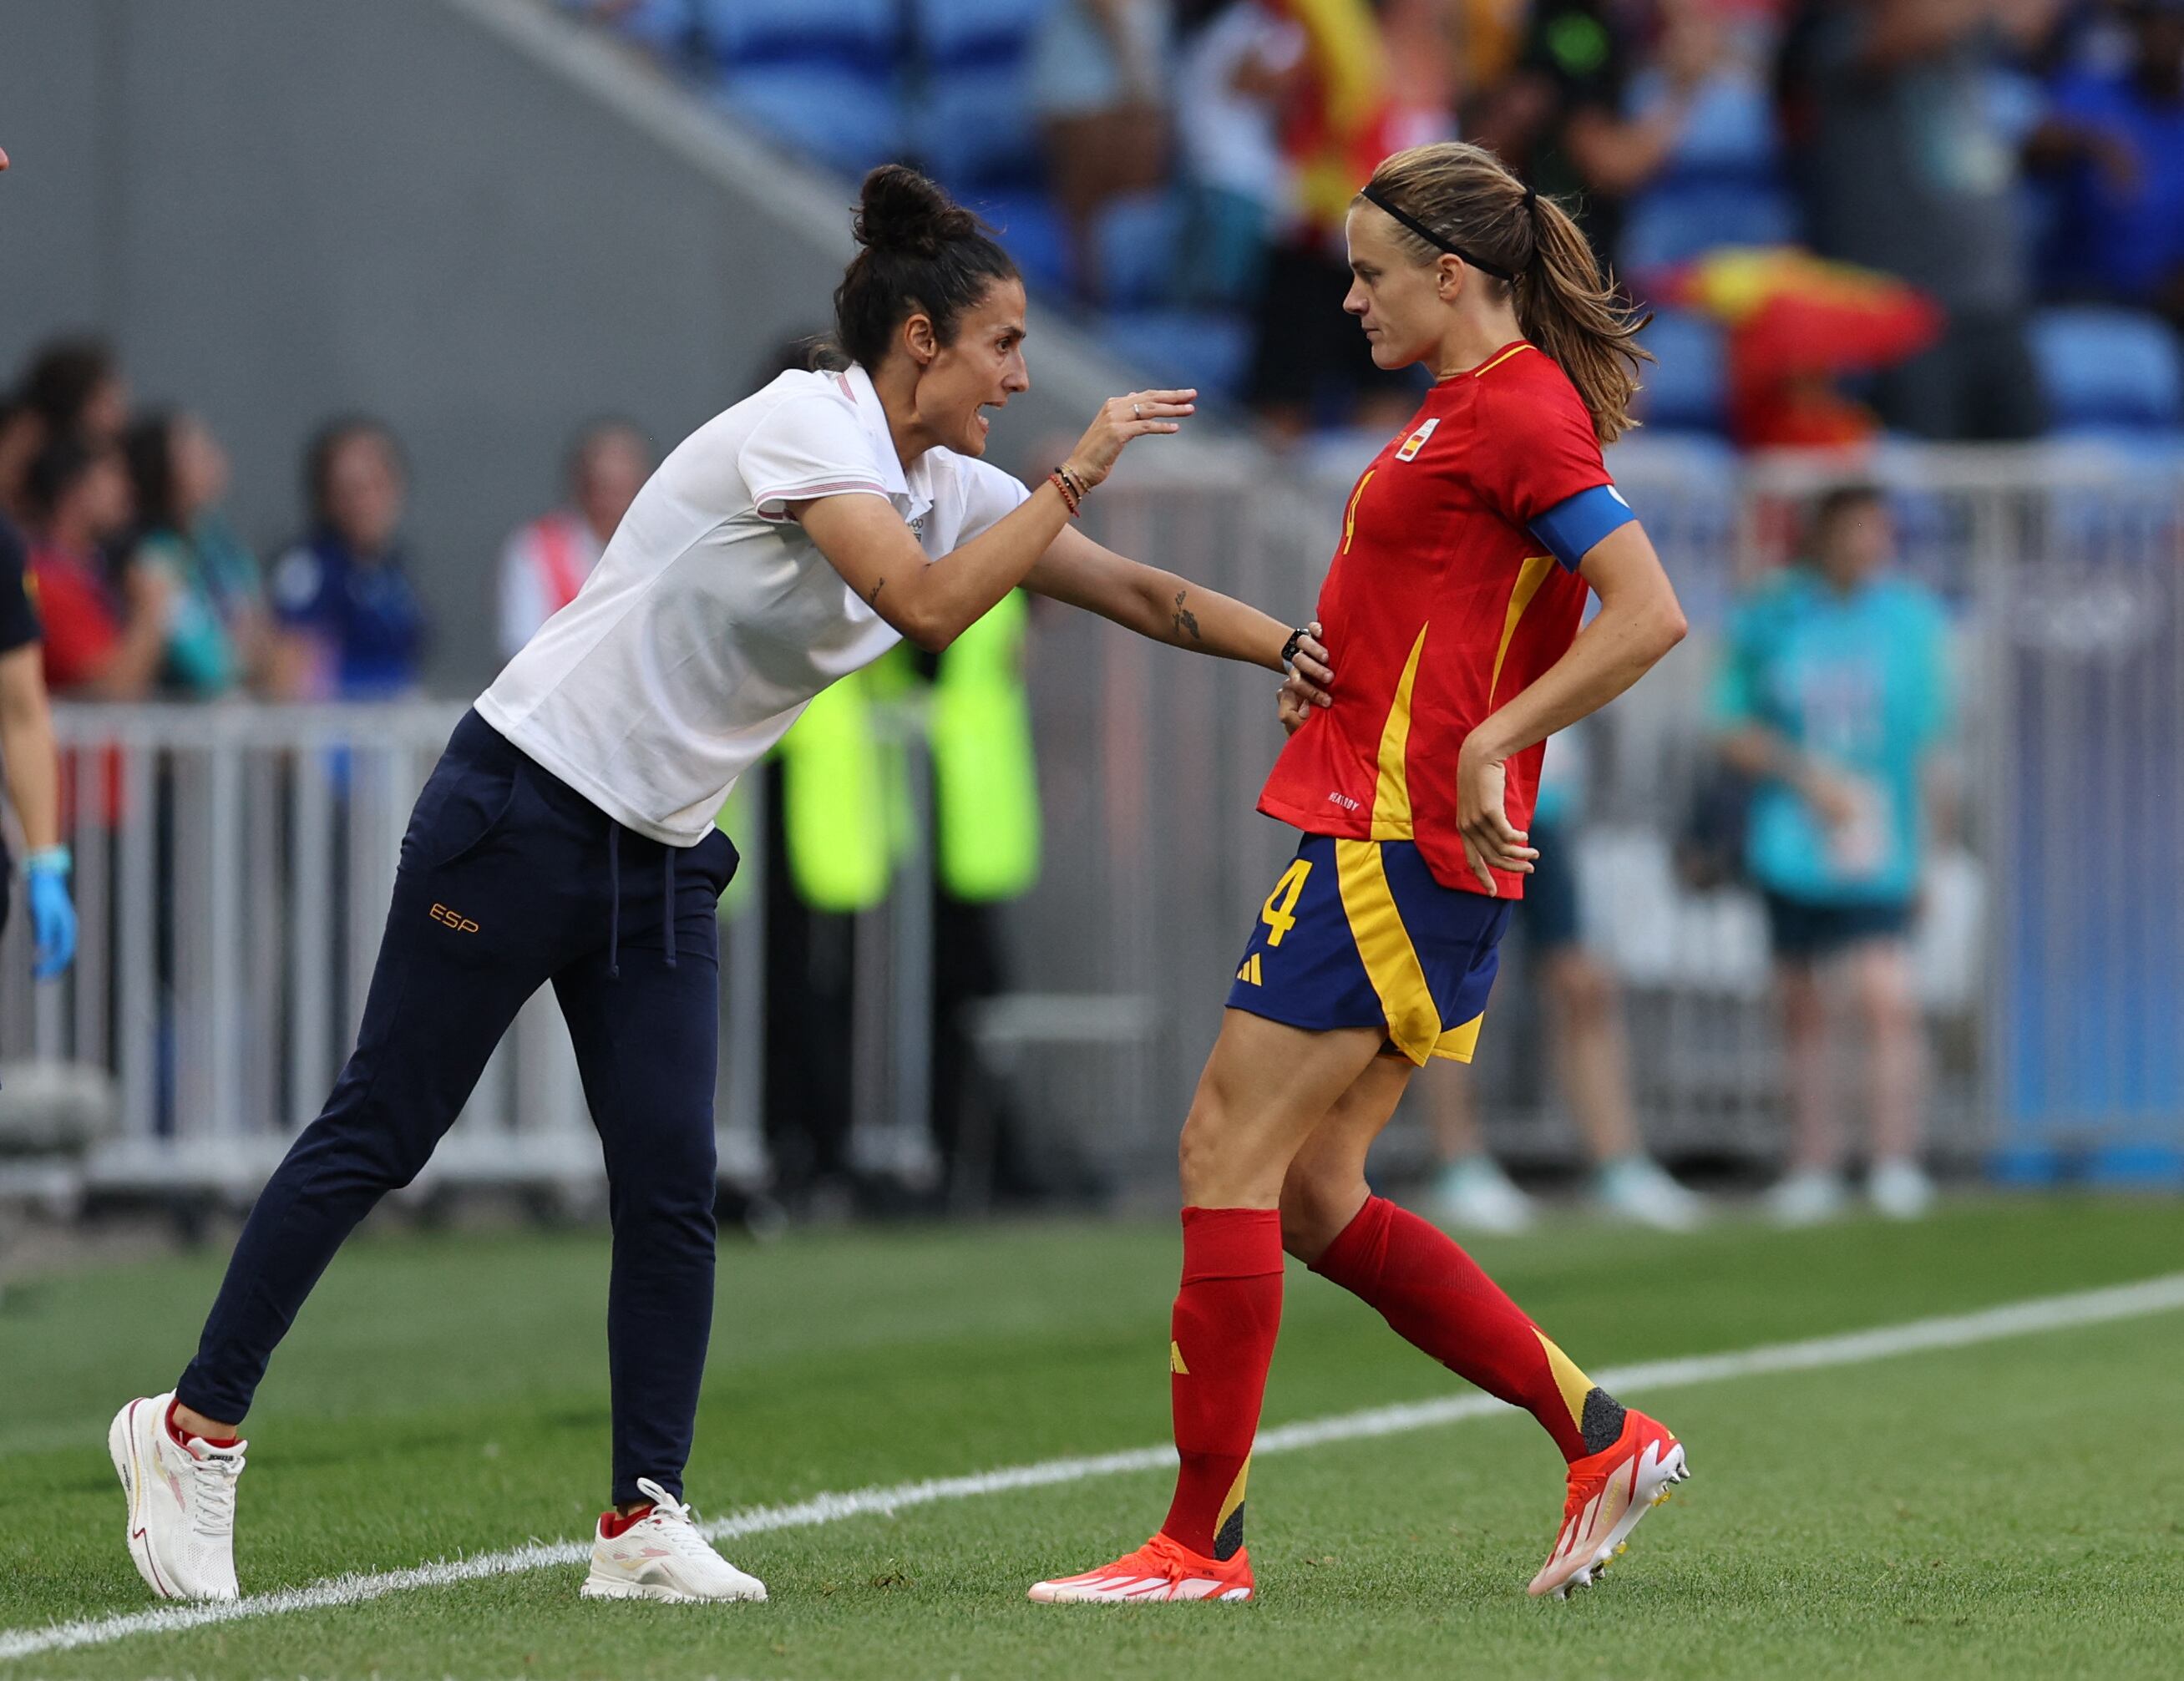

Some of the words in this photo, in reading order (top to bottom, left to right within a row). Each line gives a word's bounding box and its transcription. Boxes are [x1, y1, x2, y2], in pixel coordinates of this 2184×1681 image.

[1343, 469, 1376, 554] 4
[429, 903, 479, 933] ESP
[1262, 858, 1313, 947] 4
